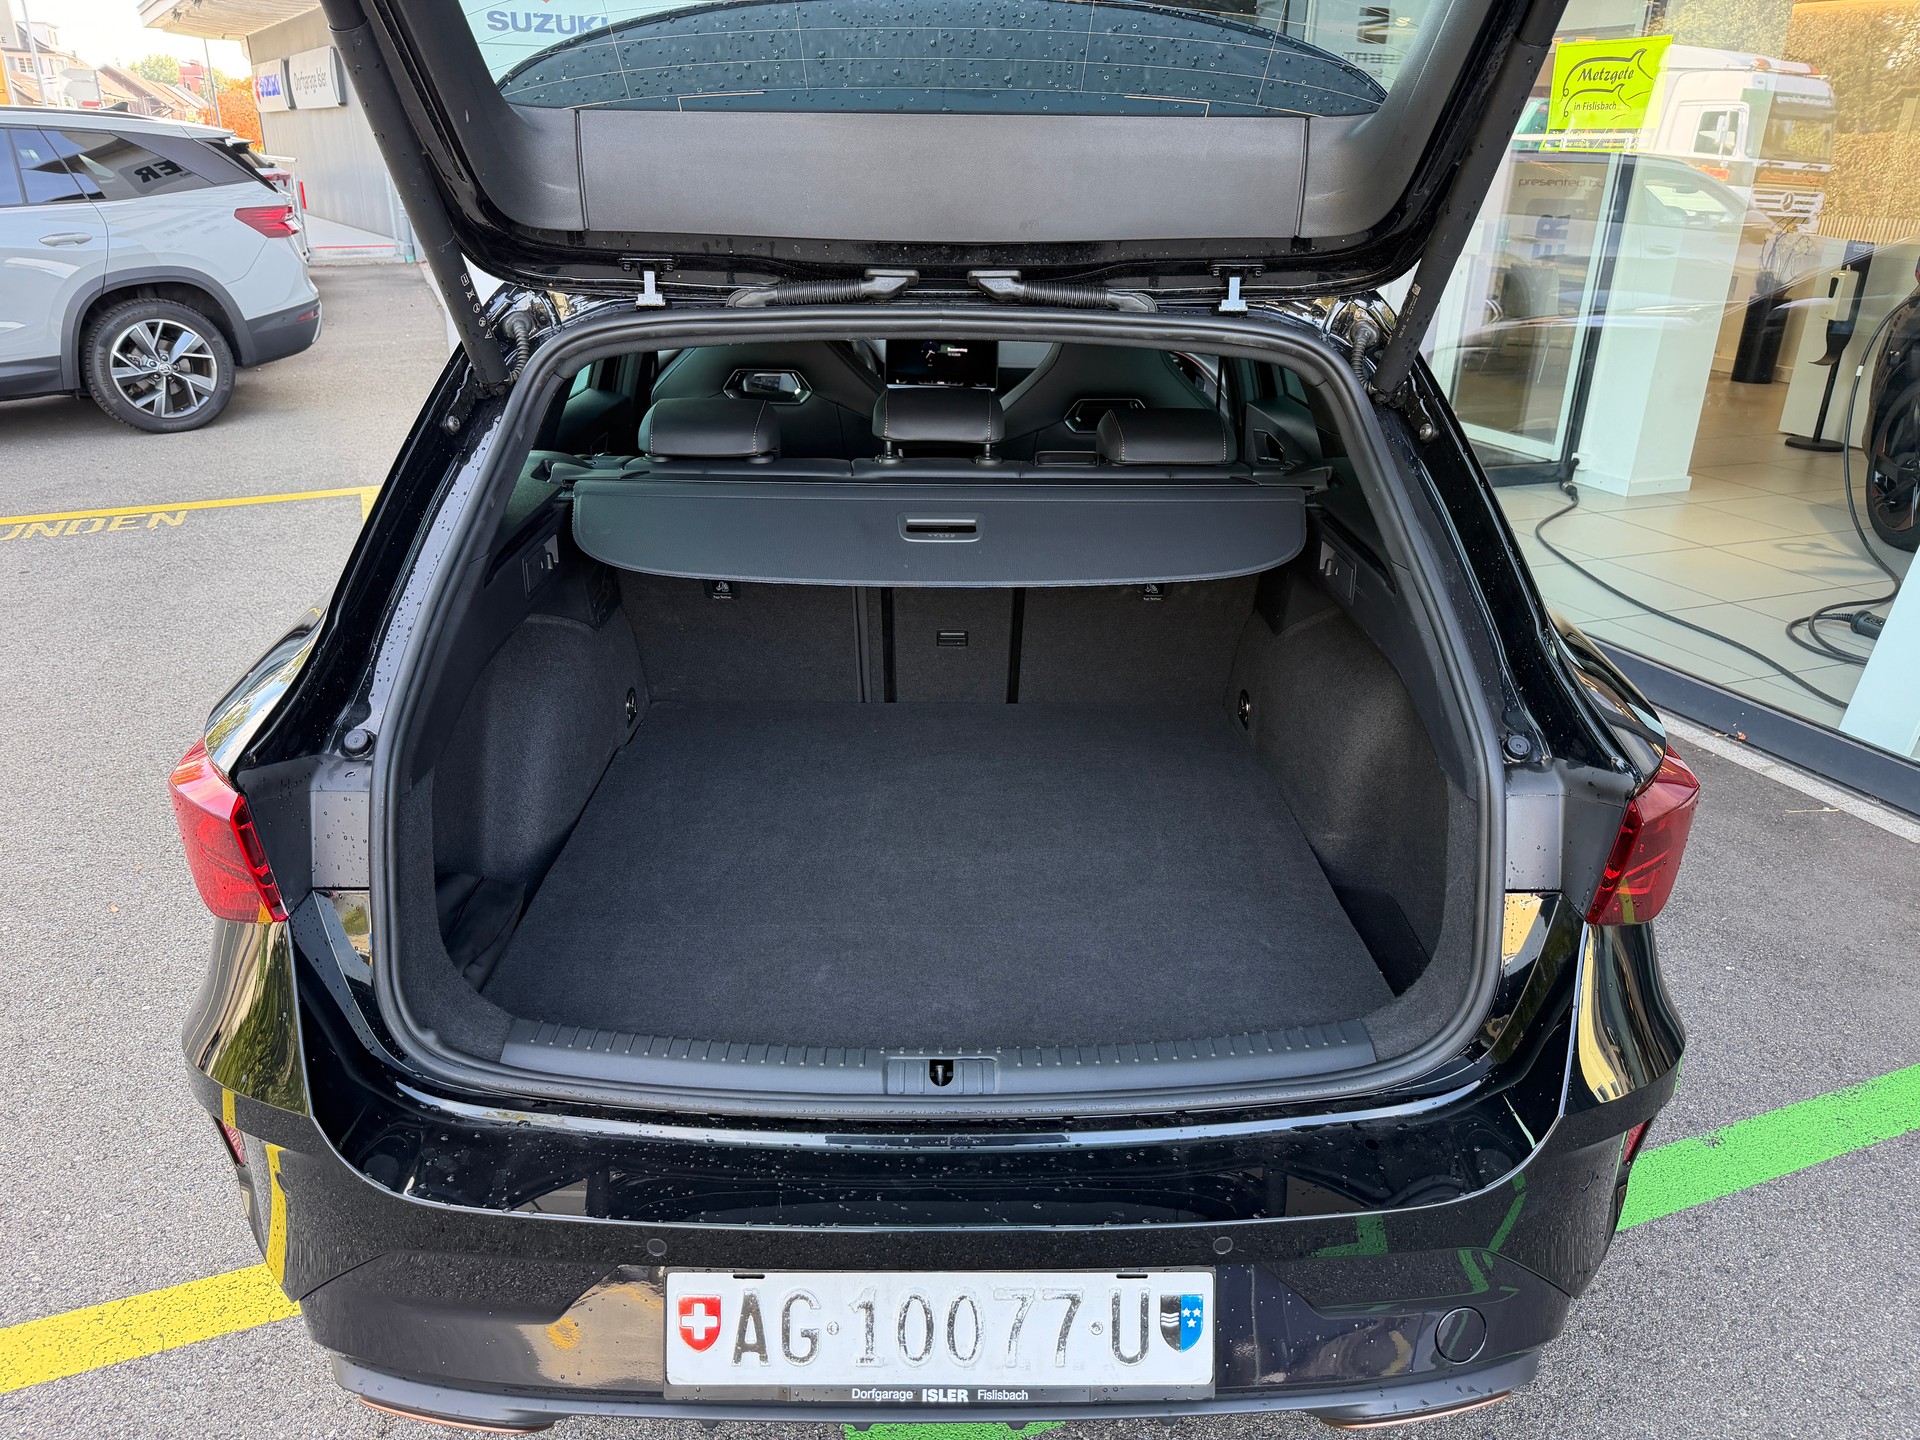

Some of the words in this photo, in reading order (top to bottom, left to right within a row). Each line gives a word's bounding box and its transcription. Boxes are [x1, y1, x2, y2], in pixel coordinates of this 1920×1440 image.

[1577, 65, 1634, 84] Metzgete
[1573, 102, 1581, 111] in
[1582, 101, 1617, 111] Fislisbach
[1518, 178, 1584, 188] presented
[851, 1388, 914, 1402] Dorfgarage
[922, 1388, 969, 1403] ISLER
[977, 1389, 1029, 1401] Fislisbach
